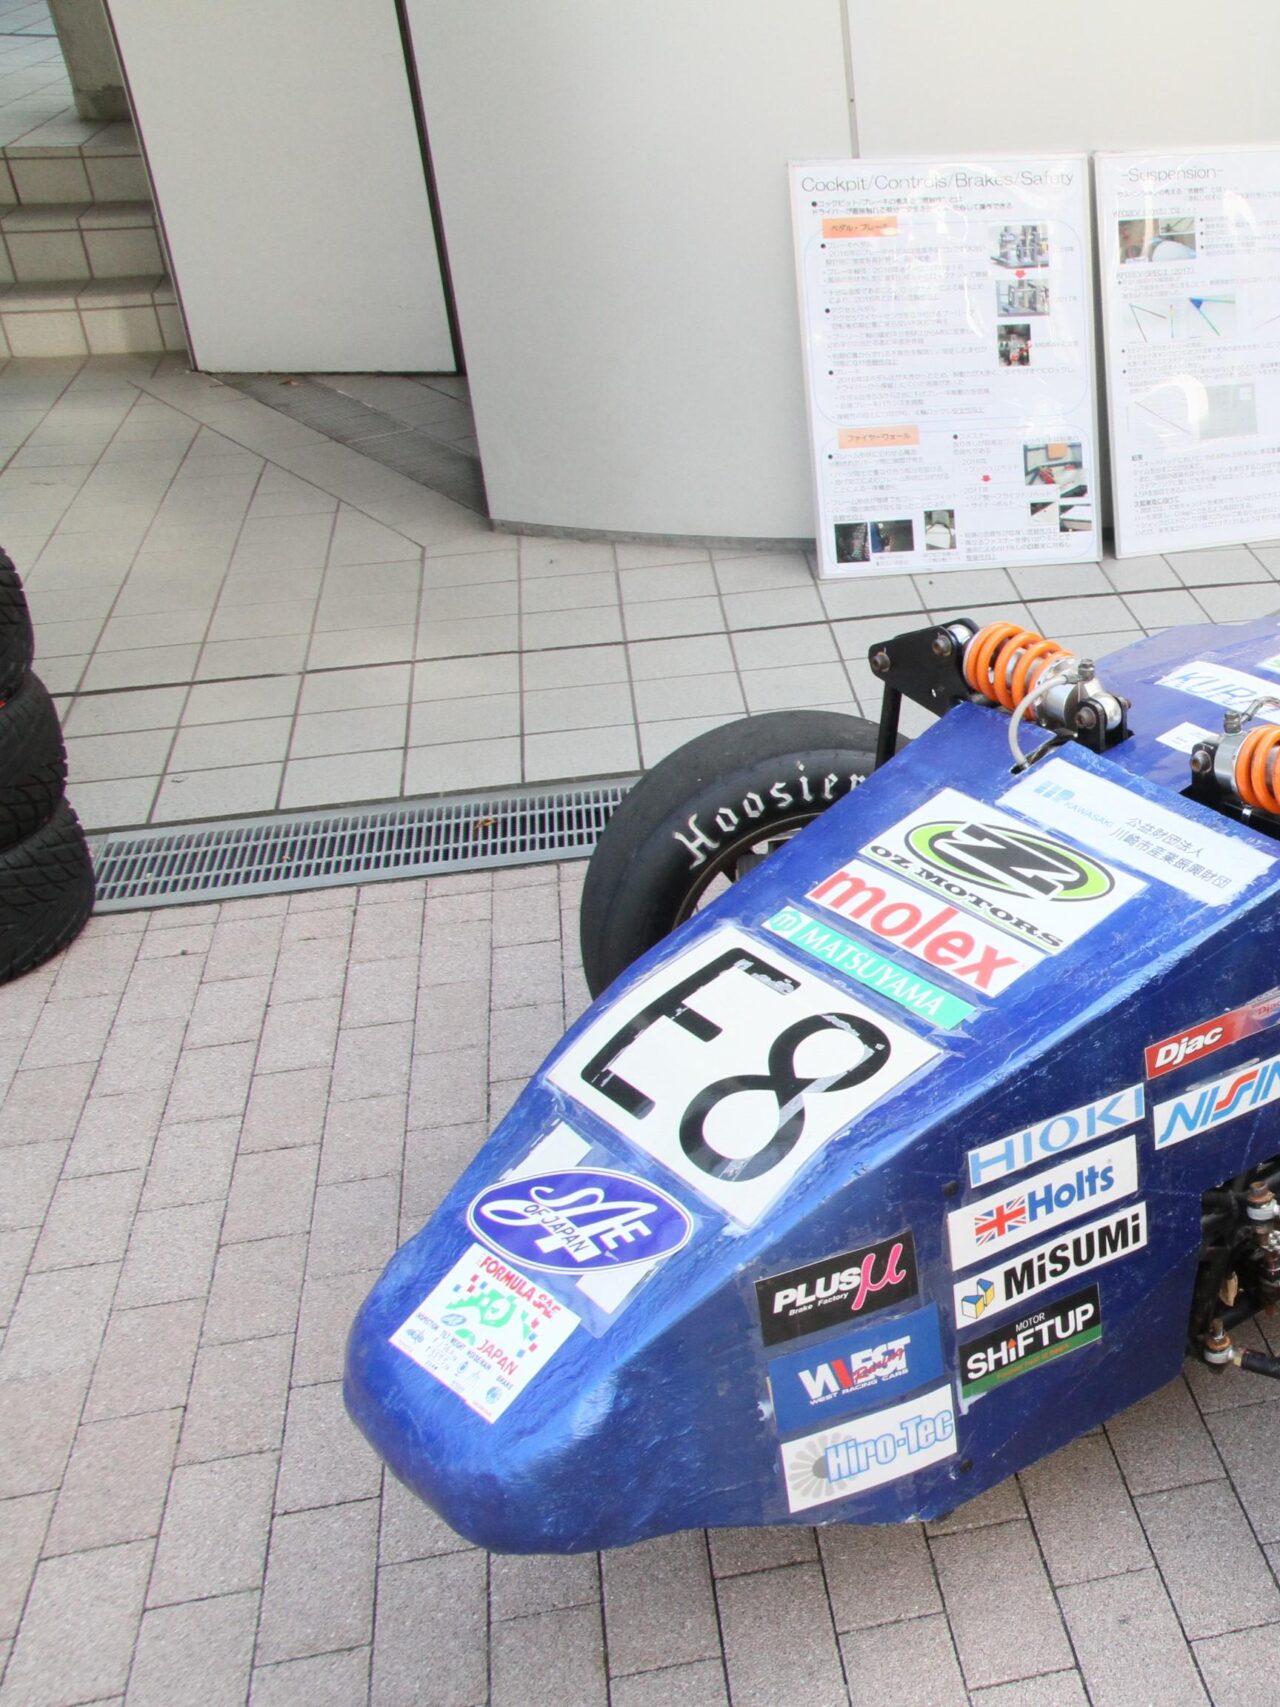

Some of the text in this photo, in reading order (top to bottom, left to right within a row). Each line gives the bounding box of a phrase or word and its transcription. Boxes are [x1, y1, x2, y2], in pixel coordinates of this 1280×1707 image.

[671, 760, 867, 870] Hoosier
[1126, 816, 1206, 858] 公益財団法人
[1111, 826, 1232, 889] 川崎市産業振興財団
[864, 844, 1065, 950] OZ MOTORS
[811, 869, 1019, 988] molex
[802, 920, 946, 1016] MATSUYAMA
[1155, 1027, 1223, 1068] Djac
[969, 1086, 1144, 1188] HIOKI
[1028, 1160, 1115, 1222] Holts
[523, 1204, 589, 1253] OF JAPAN
[1003, 1213, 1140, 1300] MiSUMi
[480, 1256, 535, 1302] FORMULA
[788, 1292, 849, 1316] Brake Factory
[1015, 1312, 1045, 1332] MOTOR
[477, 1339, 519, 1376] JAPAN
[809, 1368, 909, 1405] WEST RACING CARS
[825, 1410, 953, 1483] Hiro-Tec
